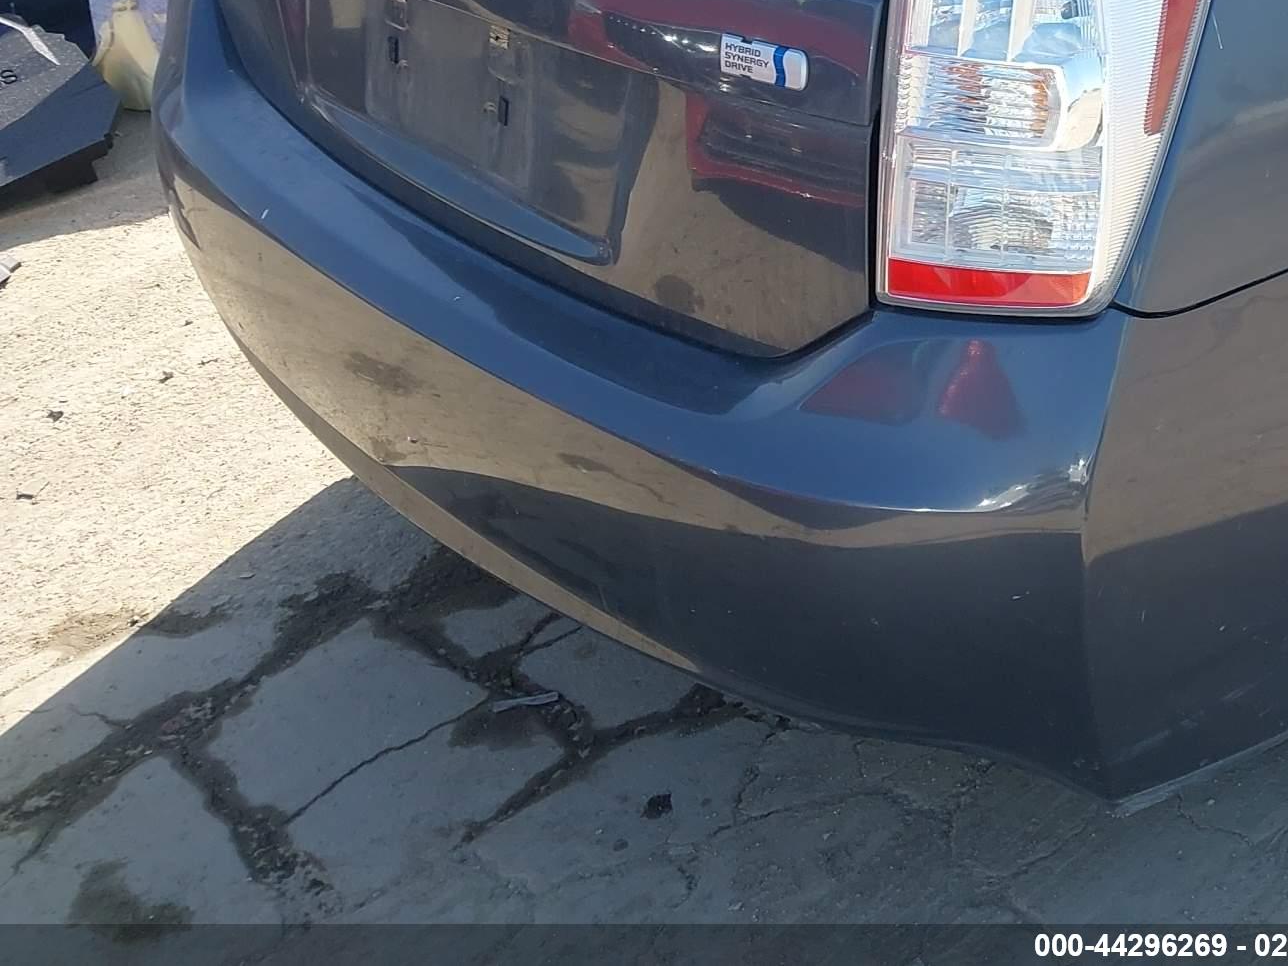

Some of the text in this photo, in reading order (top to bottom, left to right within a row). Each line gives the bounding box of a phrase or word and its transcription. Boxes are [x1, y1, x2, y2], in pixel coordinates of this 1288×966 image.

[725, 43, 760, 57] HYBRID
[725, 52, 769, 68] SYNERGY
[725, 60, 753, 73] DRIVE
